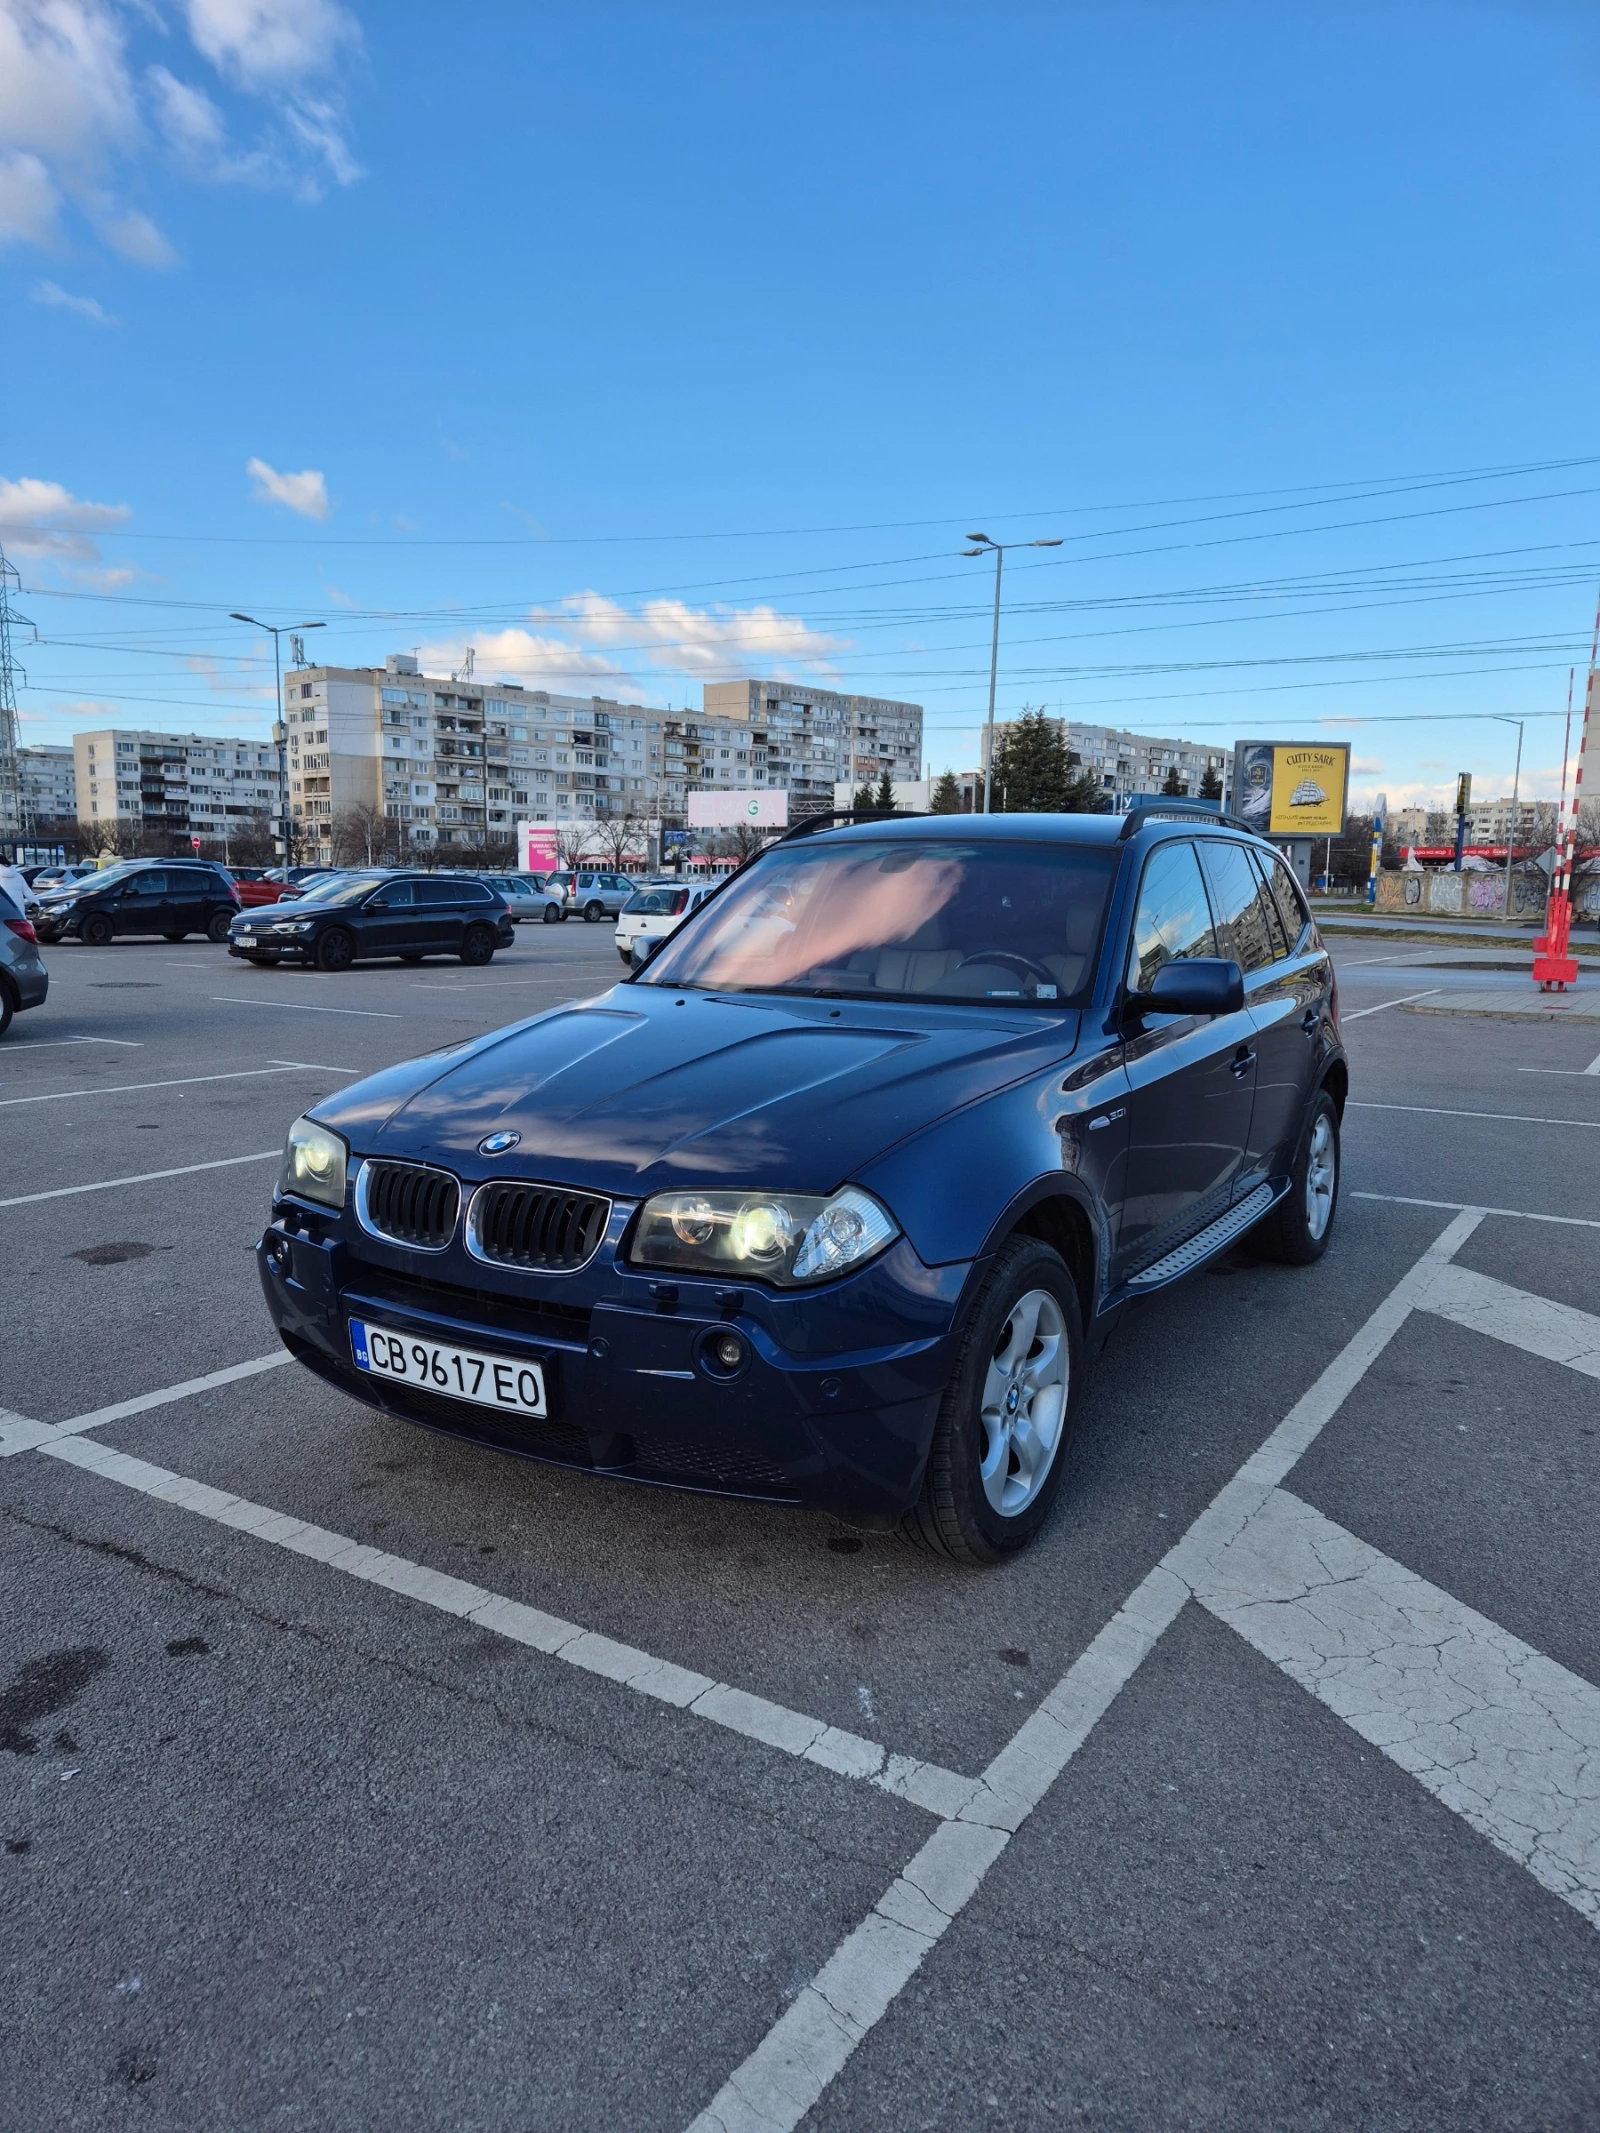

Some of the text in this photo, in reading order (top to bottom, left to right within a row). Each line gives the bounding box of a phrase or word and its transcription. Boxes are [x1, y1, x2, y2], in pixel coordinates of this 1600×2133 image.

[1286, 753, 1336, 767] CUTTY SARK
[356, 1348, 369, 1363] BG
